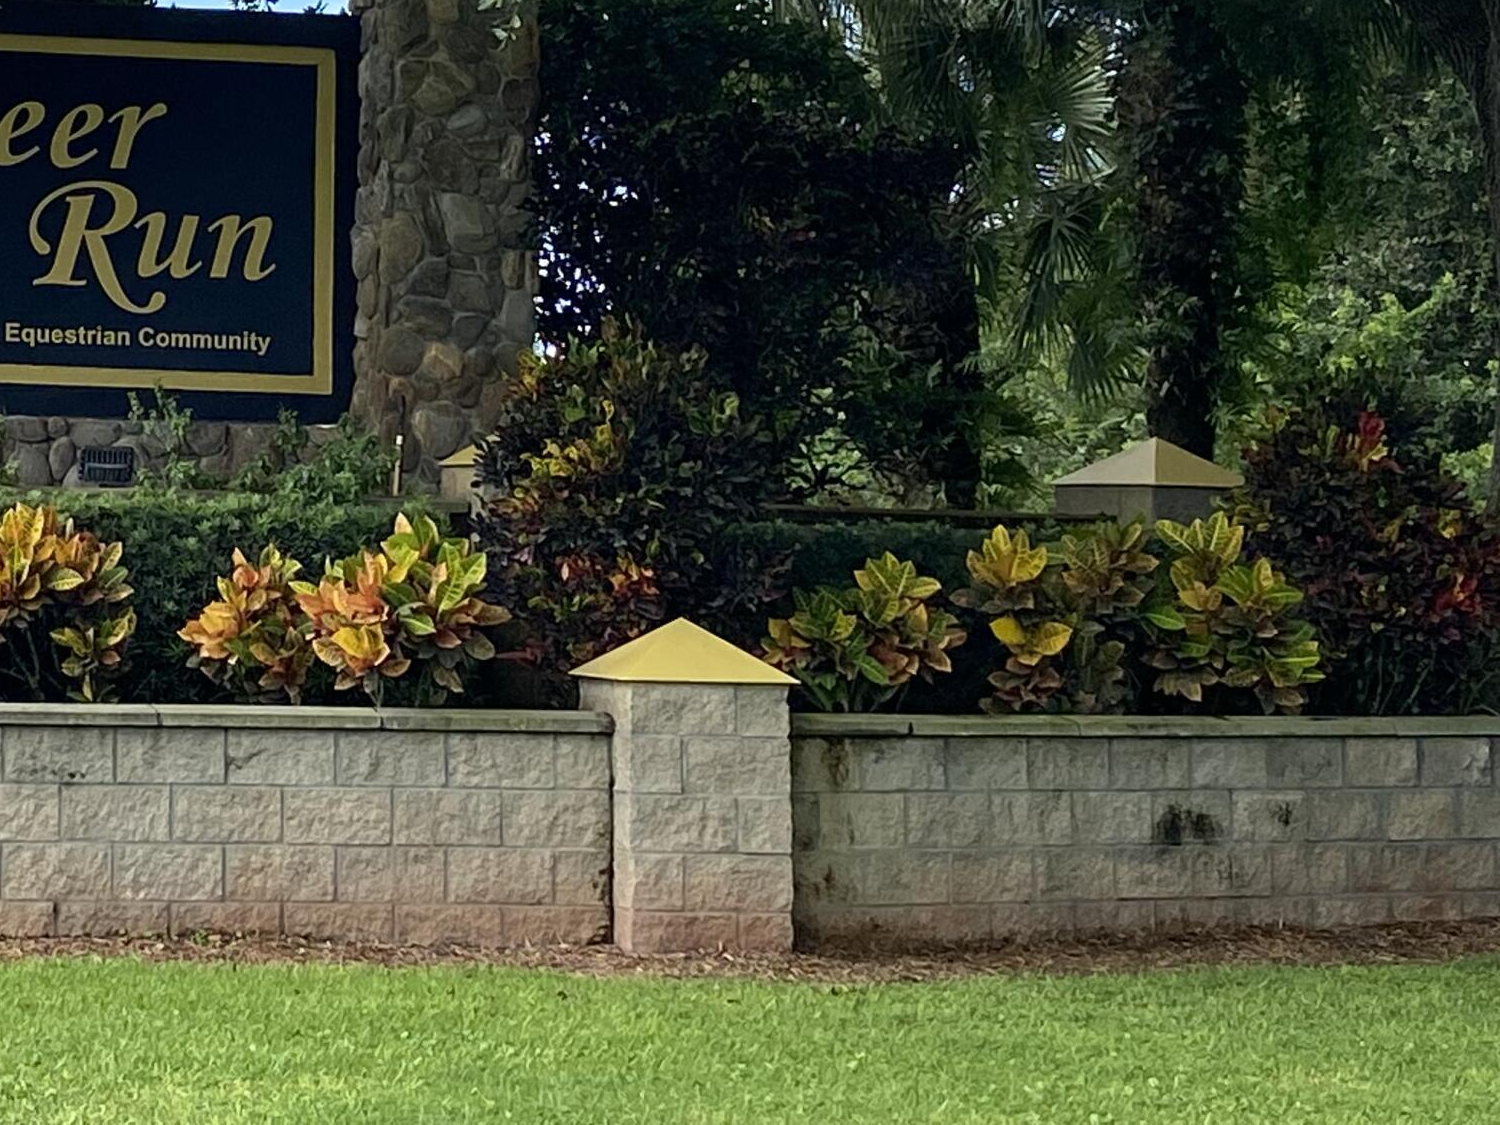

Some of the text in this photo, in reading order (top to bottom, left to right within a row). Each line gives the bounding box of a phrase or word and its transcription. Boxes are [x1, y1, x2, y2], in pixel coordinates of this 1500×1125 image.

[29, 181, 277, 314] Run
[5, 322, 131, 348] Equestrian
[138, 327, 271, 356] Community
